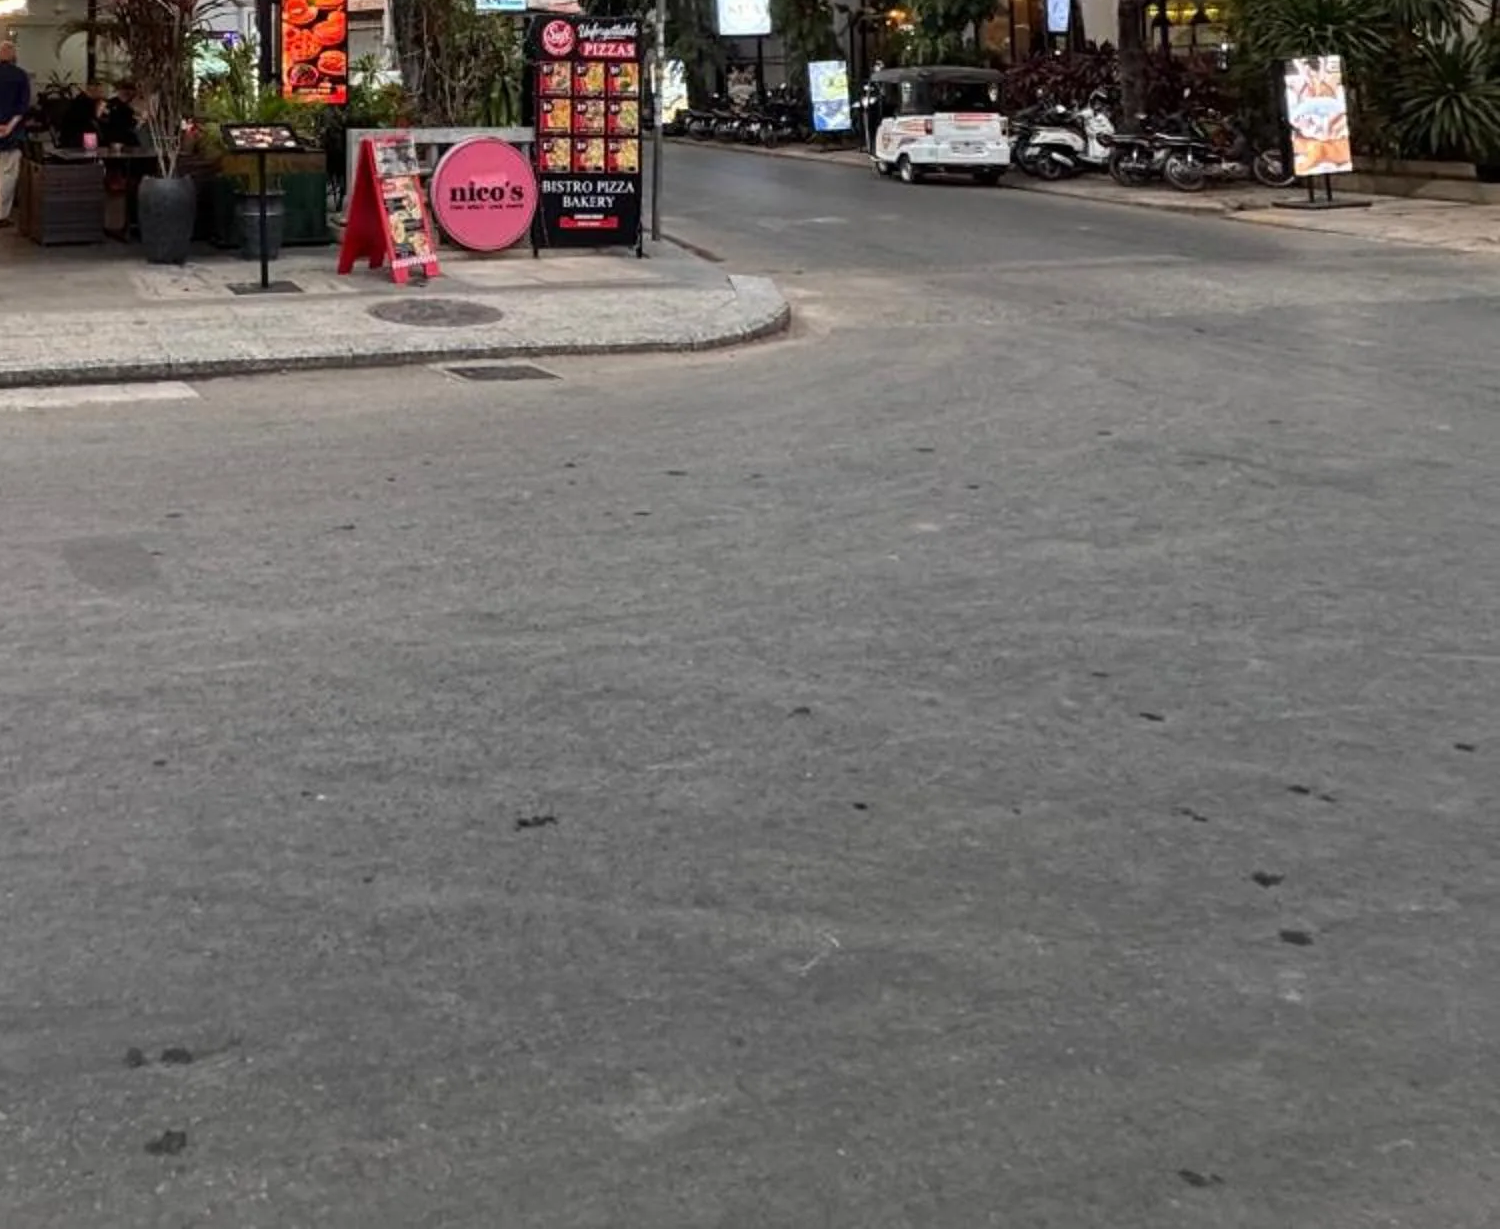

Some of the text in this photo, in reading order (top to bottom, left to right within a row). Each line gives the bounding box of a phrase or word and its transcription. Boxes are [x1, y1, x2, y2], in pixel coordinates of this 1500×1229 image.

[584, 42, 635, 58] PIZZAS
[450, 181, 524, 202] nico's
[542, 180, 635, 194] BISTRO PIZZA
[563, 195, 615, 208] BAKERY
